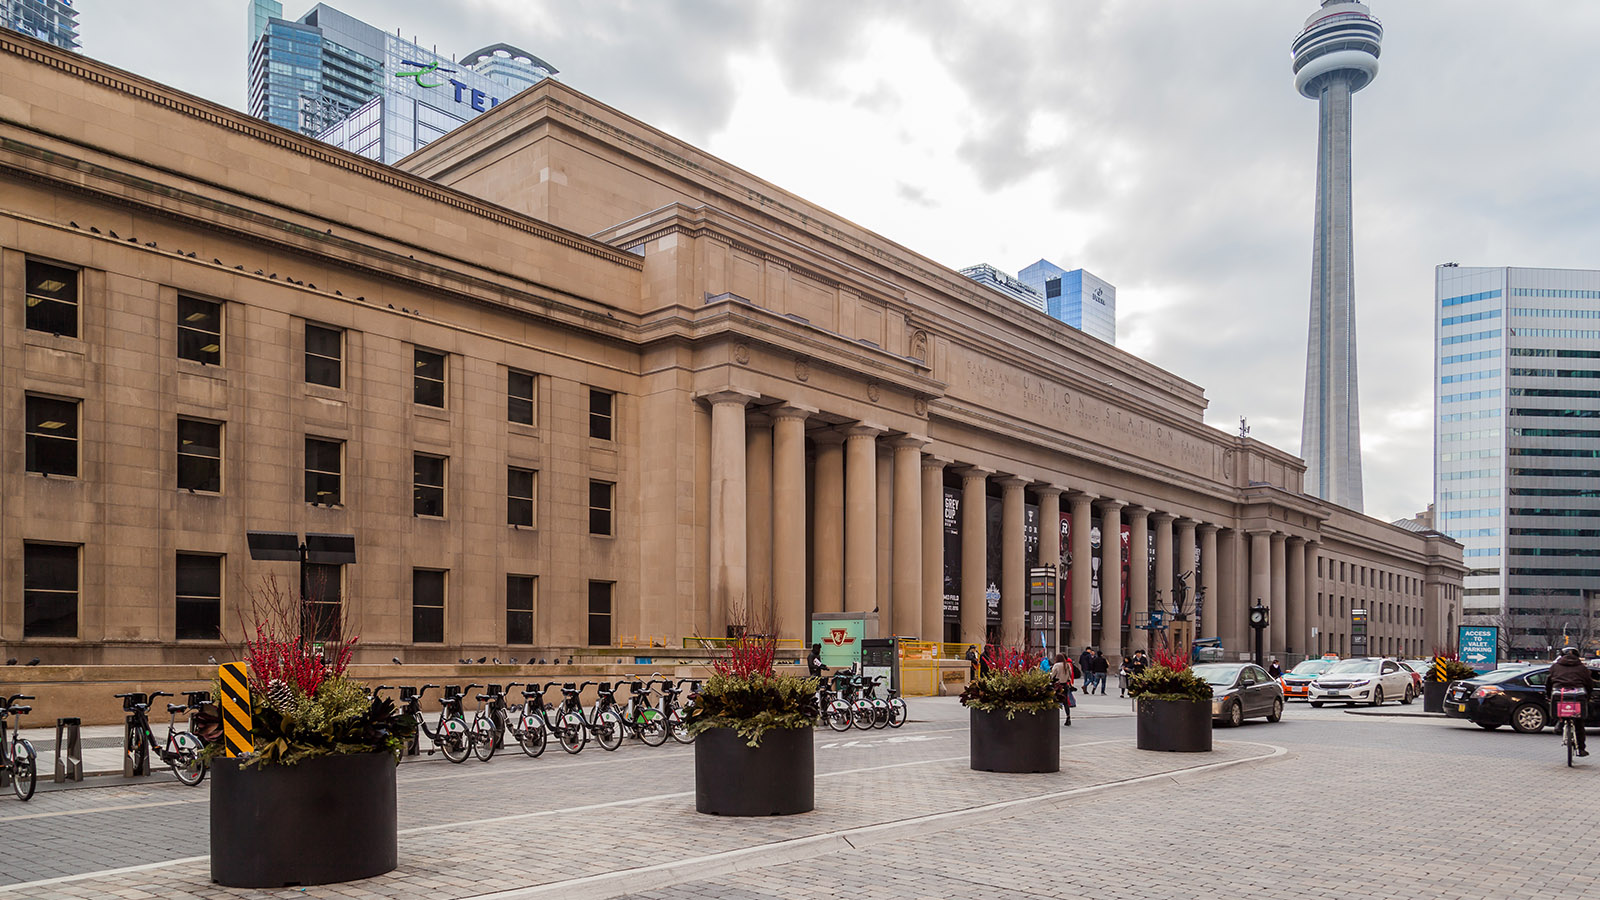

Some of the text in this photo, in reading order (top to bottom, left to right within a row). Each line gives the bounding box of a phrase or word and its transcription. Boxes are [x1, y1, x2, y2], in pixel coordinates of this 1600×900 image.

[1023, 376, 1085, 409] UNION
[1105, 407, 1173, 441] STATION
[944, 497, 960, 511] GREY
[944, 508, 956, 519] CUP
